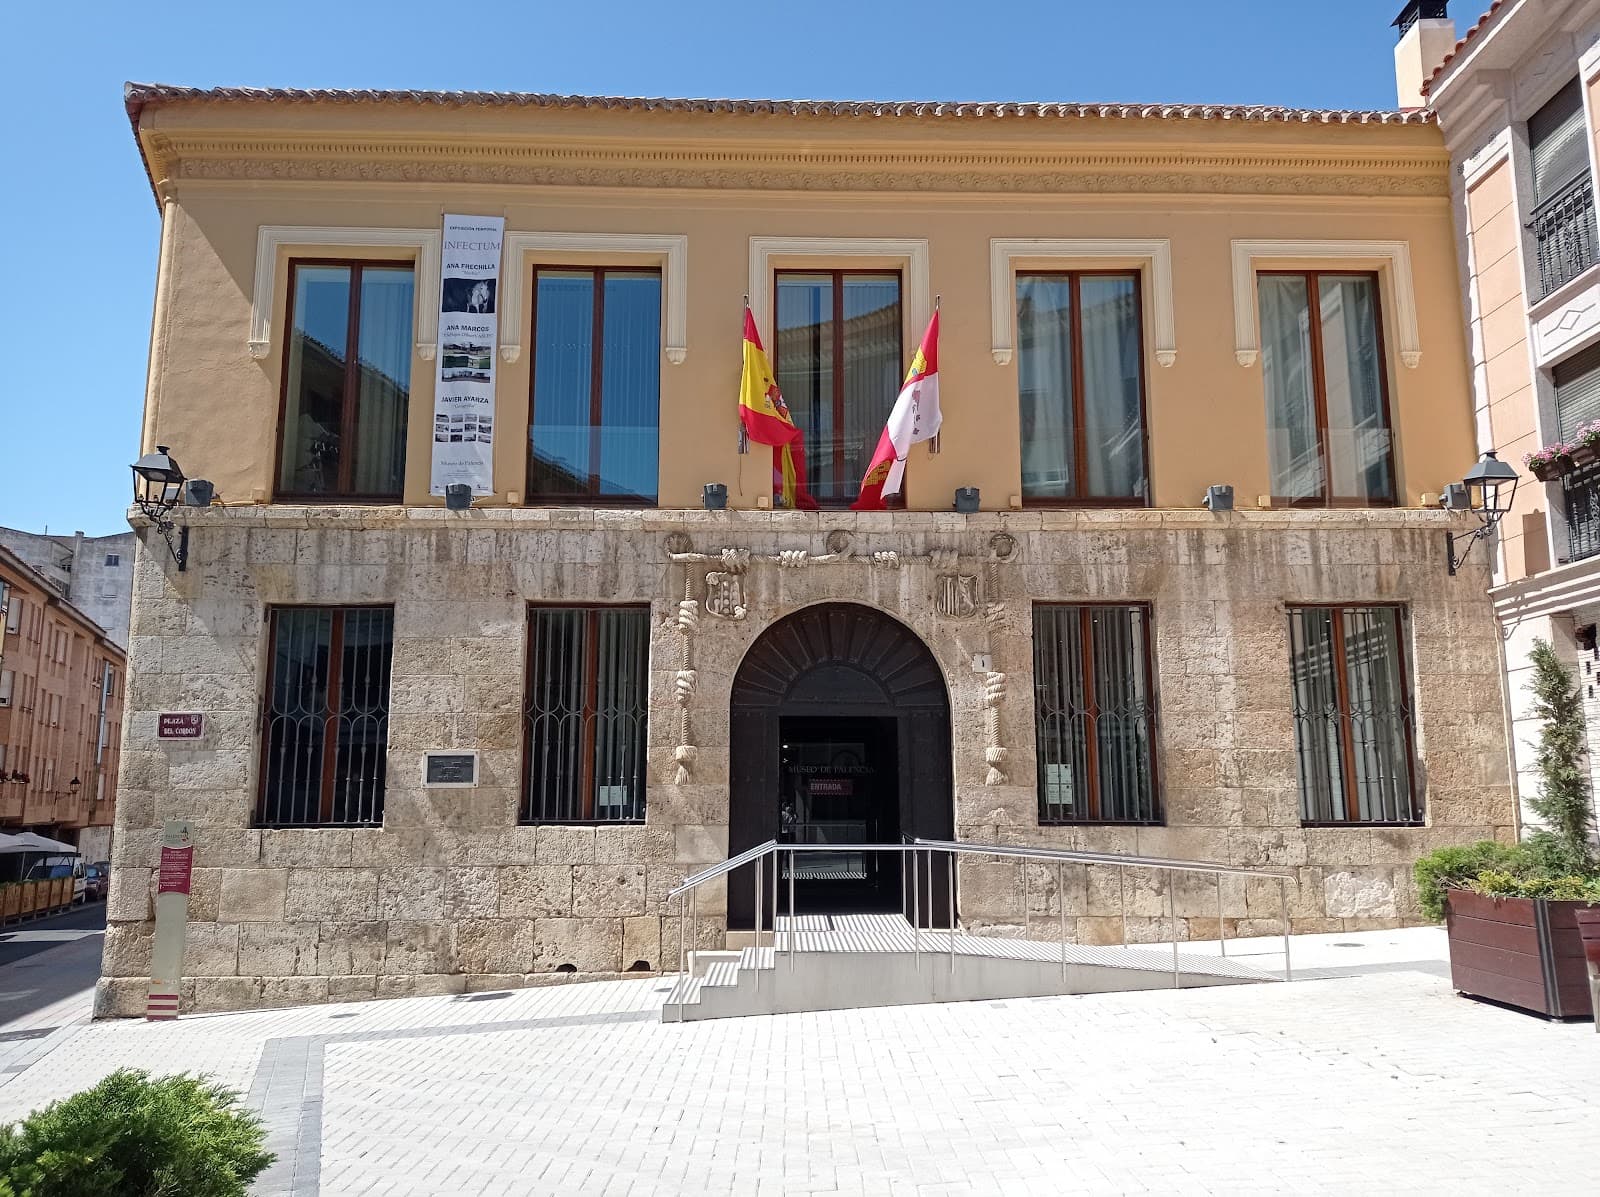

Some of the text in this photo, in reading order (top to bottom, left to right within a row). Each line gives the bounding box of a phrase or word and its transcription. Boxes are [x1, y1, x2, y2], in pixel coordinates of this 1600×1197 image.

[444, 240, 501, 251] INFECTUM
[461, 324, 490, 332] MARCOS
[163, 717, 184, 725] PLAZA
[163, 727, 173, 735] DEL
[810, 783, 842, 791] ENTRADA
